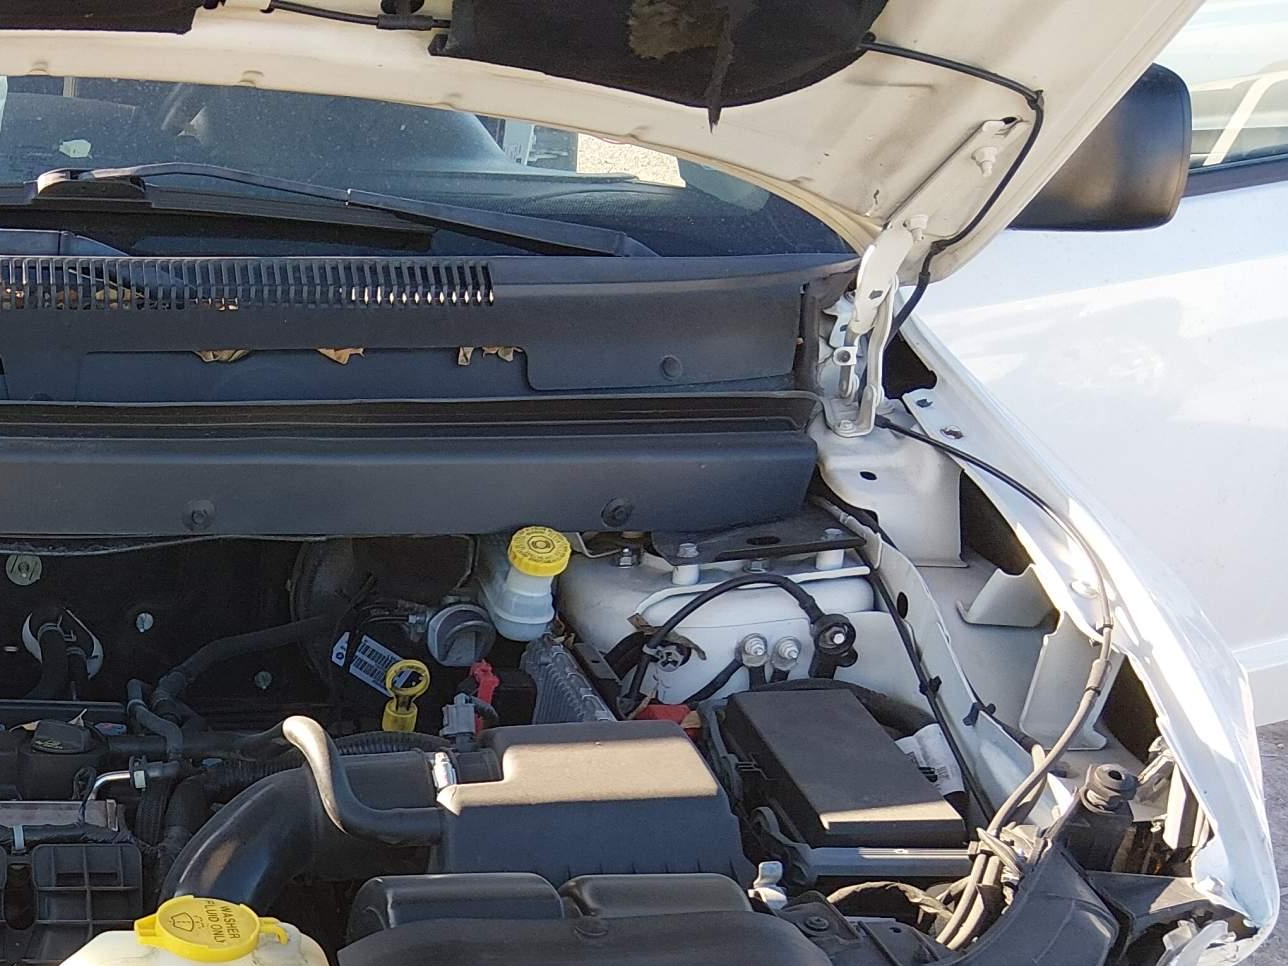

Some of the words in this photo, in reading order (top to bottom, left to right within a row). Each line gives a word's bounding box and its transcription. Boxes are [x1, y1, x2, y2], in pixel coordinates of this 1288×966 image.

[204, 900, 220, 923] FLUID
[219, 905, 241, 940] WASHER
[210, 923, 226, 944] ONLY
